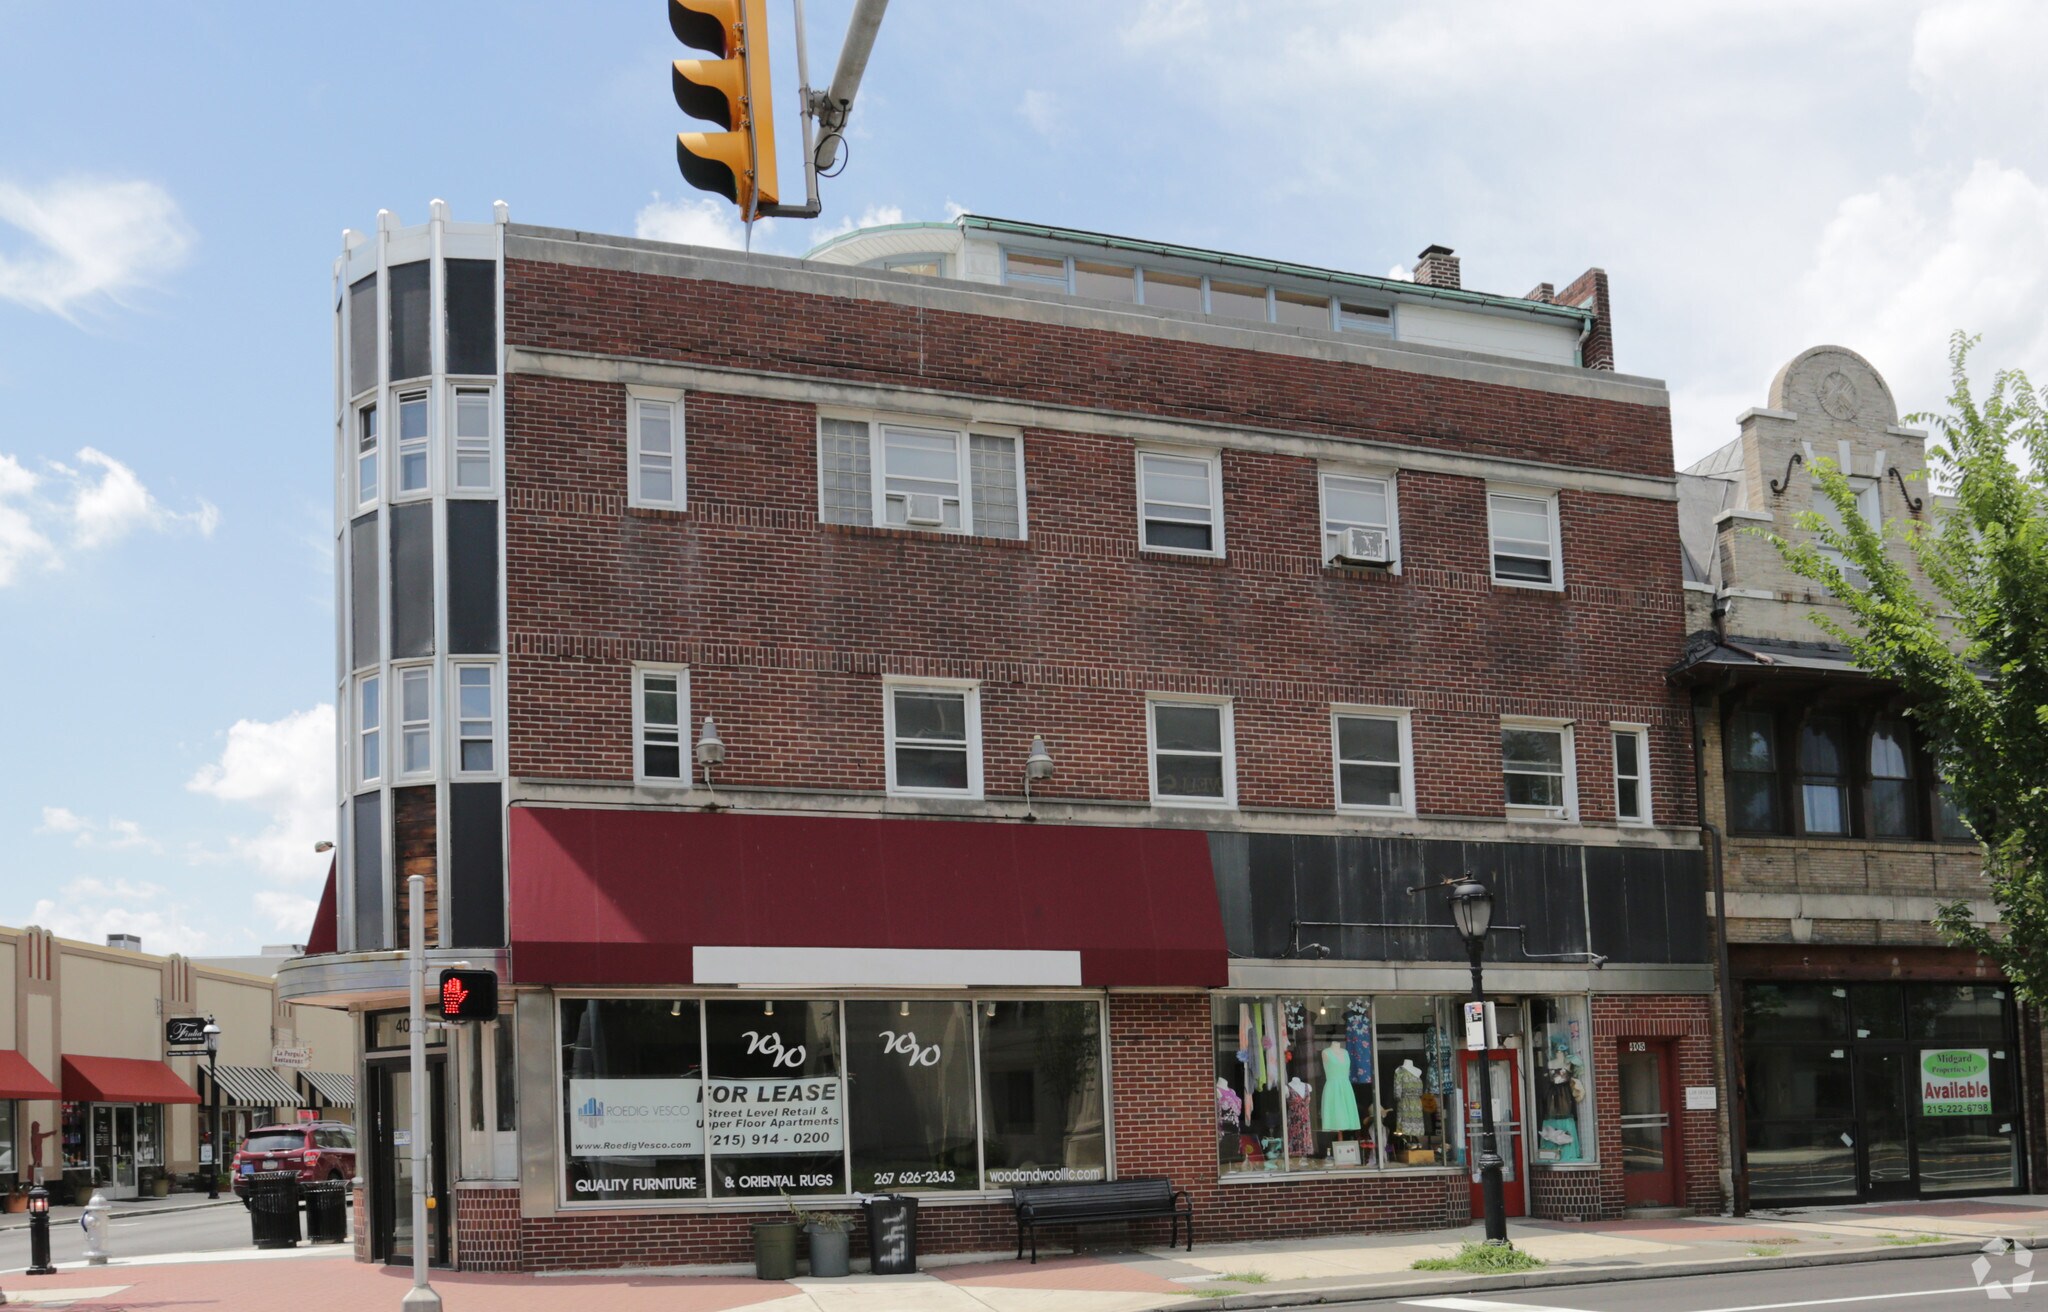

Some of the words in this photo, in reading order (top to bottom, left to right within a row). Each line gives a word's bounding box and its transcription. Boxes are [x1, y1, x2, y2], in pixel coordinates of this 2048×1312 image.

[1937, 1054, 1972, 1064] Midgard
[696, 1085, 748, 1103] FOR
[757, 1083, 836, 1102] LEASE
[1925, 1081, 1988, 1099] Available
[607, 1105, 649, 1117] ROEDIG
[652, 1105, 690, 1117] VESCO
[708, 1108, 742, 1118] Street
[746, 1108, 778, 1118] Level
[781, 1106, 817, 1117] Retail
[820, 1106, 829, 1115] &
[1927, 1103, 1989, 1114] 215-222-6798
[736, 1118, 766, 1128] Floor
[770, 1117, 839, 1128] Apartments
[751, 1133, 779, 1145] 914
[793, 1132, 830, 1144] 0200
[575, 1141, 691, 1151] www.RoedigVesco.com
[724, 1176, 735, 1189] &
[739, 1175, 796, 1188] ORIENTAL
[799, 1174, 834, 1187] RUGS
[874, 1172, 894, 1185] 267
[899, 1170, 956, 1184] 626-2343
[989, 1168, 1100, 1183] woodandwoolllc.com
[575, 1178, 629, 1192] QUALITY
[633, 1177, 697, 1190] FURNITURE
